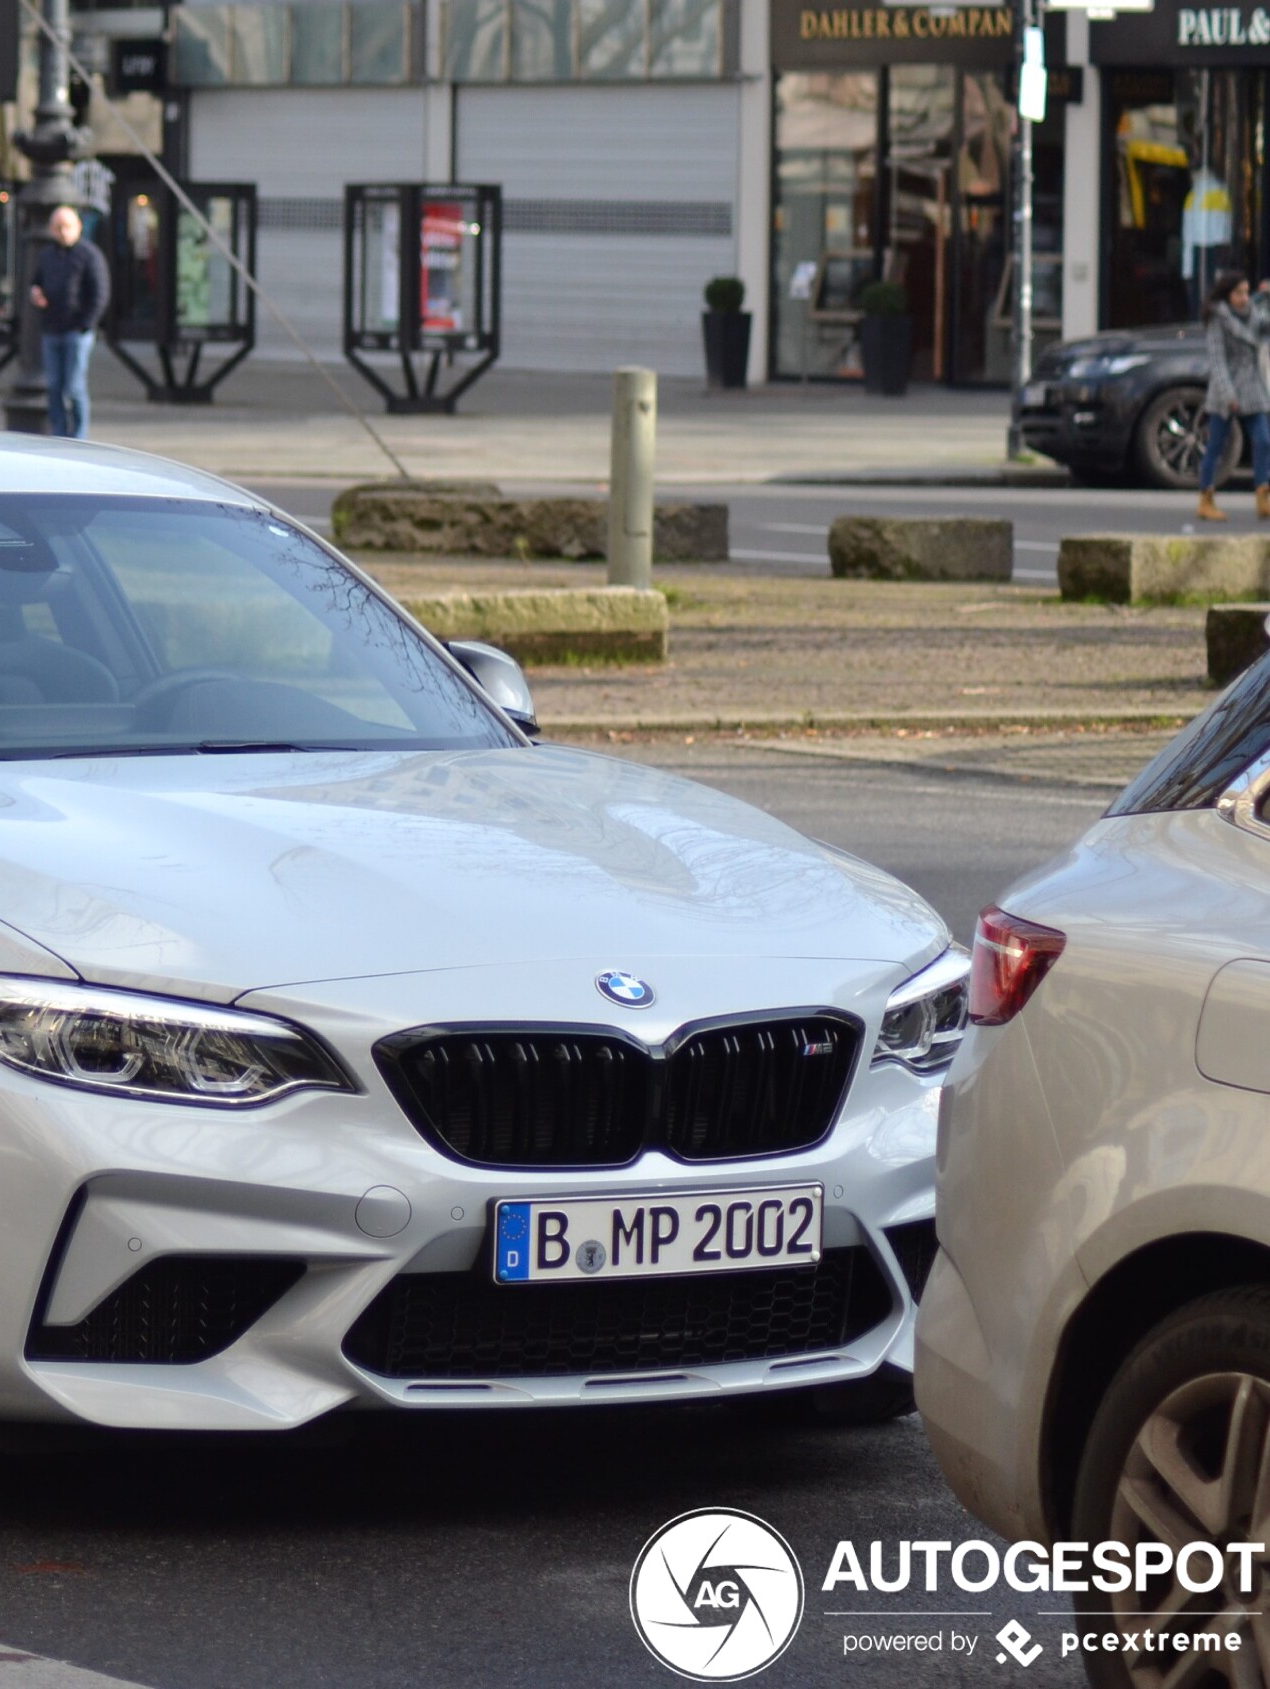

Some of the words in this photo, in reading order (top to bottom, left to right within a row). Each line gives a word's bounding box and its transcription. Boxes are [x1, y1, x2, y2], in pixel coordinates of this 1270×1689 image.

[800, 10, 890, 39] DAHLER
[912, 8, 1013, 37] COMPAN
[1178, 8, 1246, 45] PAUL
[538, 1211, 570, 1269] B
[612, 1206, 680, 1265] MP
[693, 1197, 814, 1262] 2002
[507, 1251, 518, 1267] D
